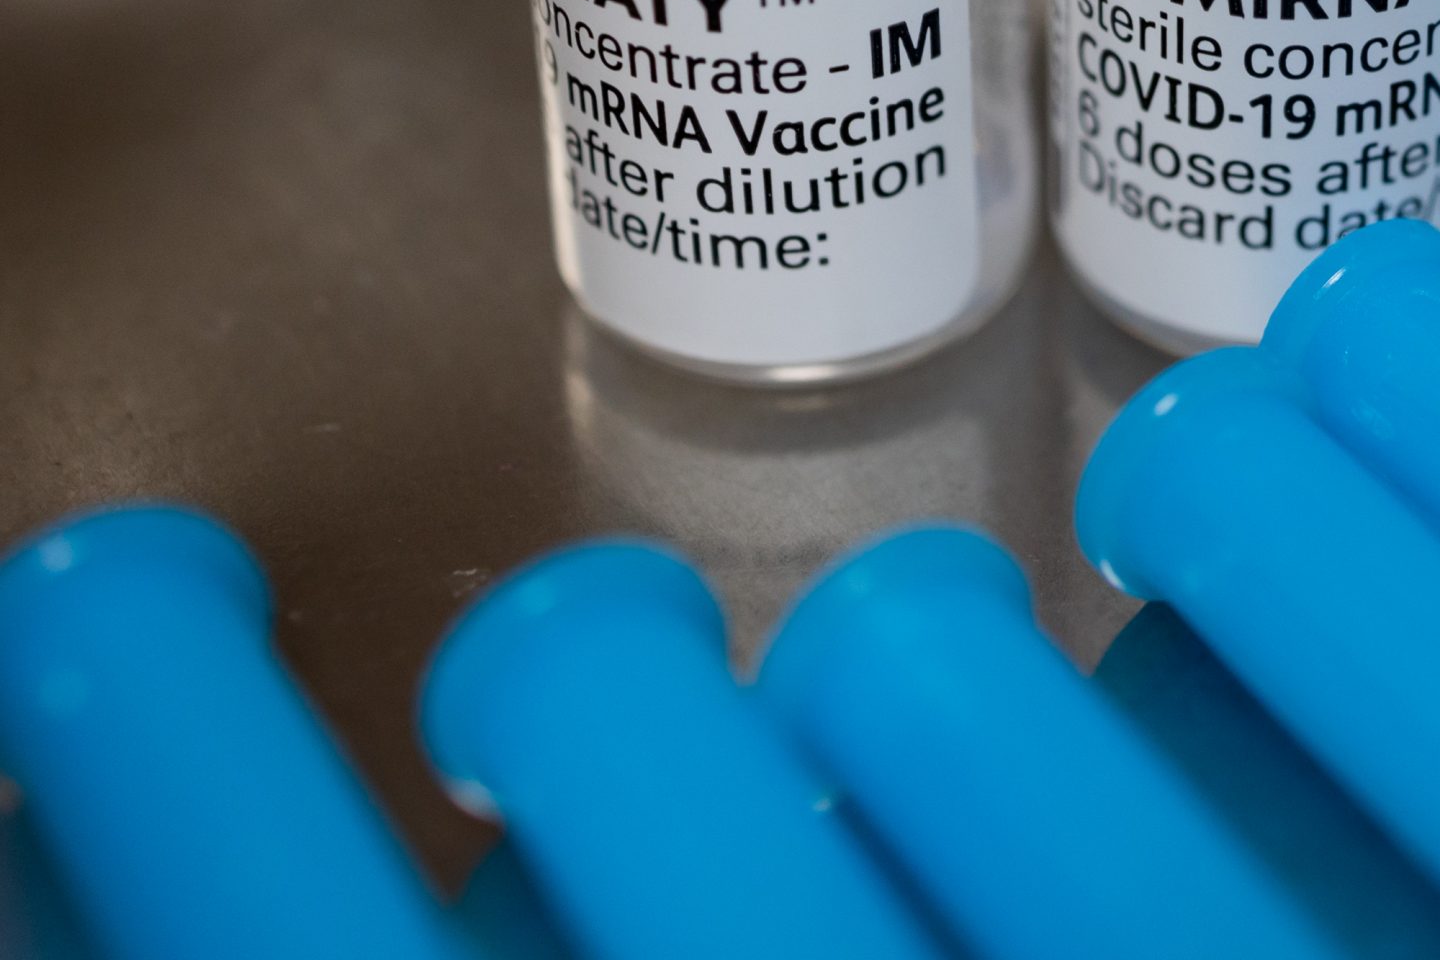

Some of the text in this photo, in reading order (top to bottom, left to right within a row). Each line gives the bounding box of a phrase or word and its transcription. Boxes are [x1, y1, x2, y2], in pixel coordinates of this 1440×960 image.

[869, 7, 942, 79] IM
[1077, 31, 1317, 141] COVID-19
[566, 70, 713, 155] mRNA
[725, 85, 946, 157] Vaccine
[565, 123, 947, 216] after dilution
[1078, 140, 1274, 252] Discard
[1116, 121, 1293, 198] doses
